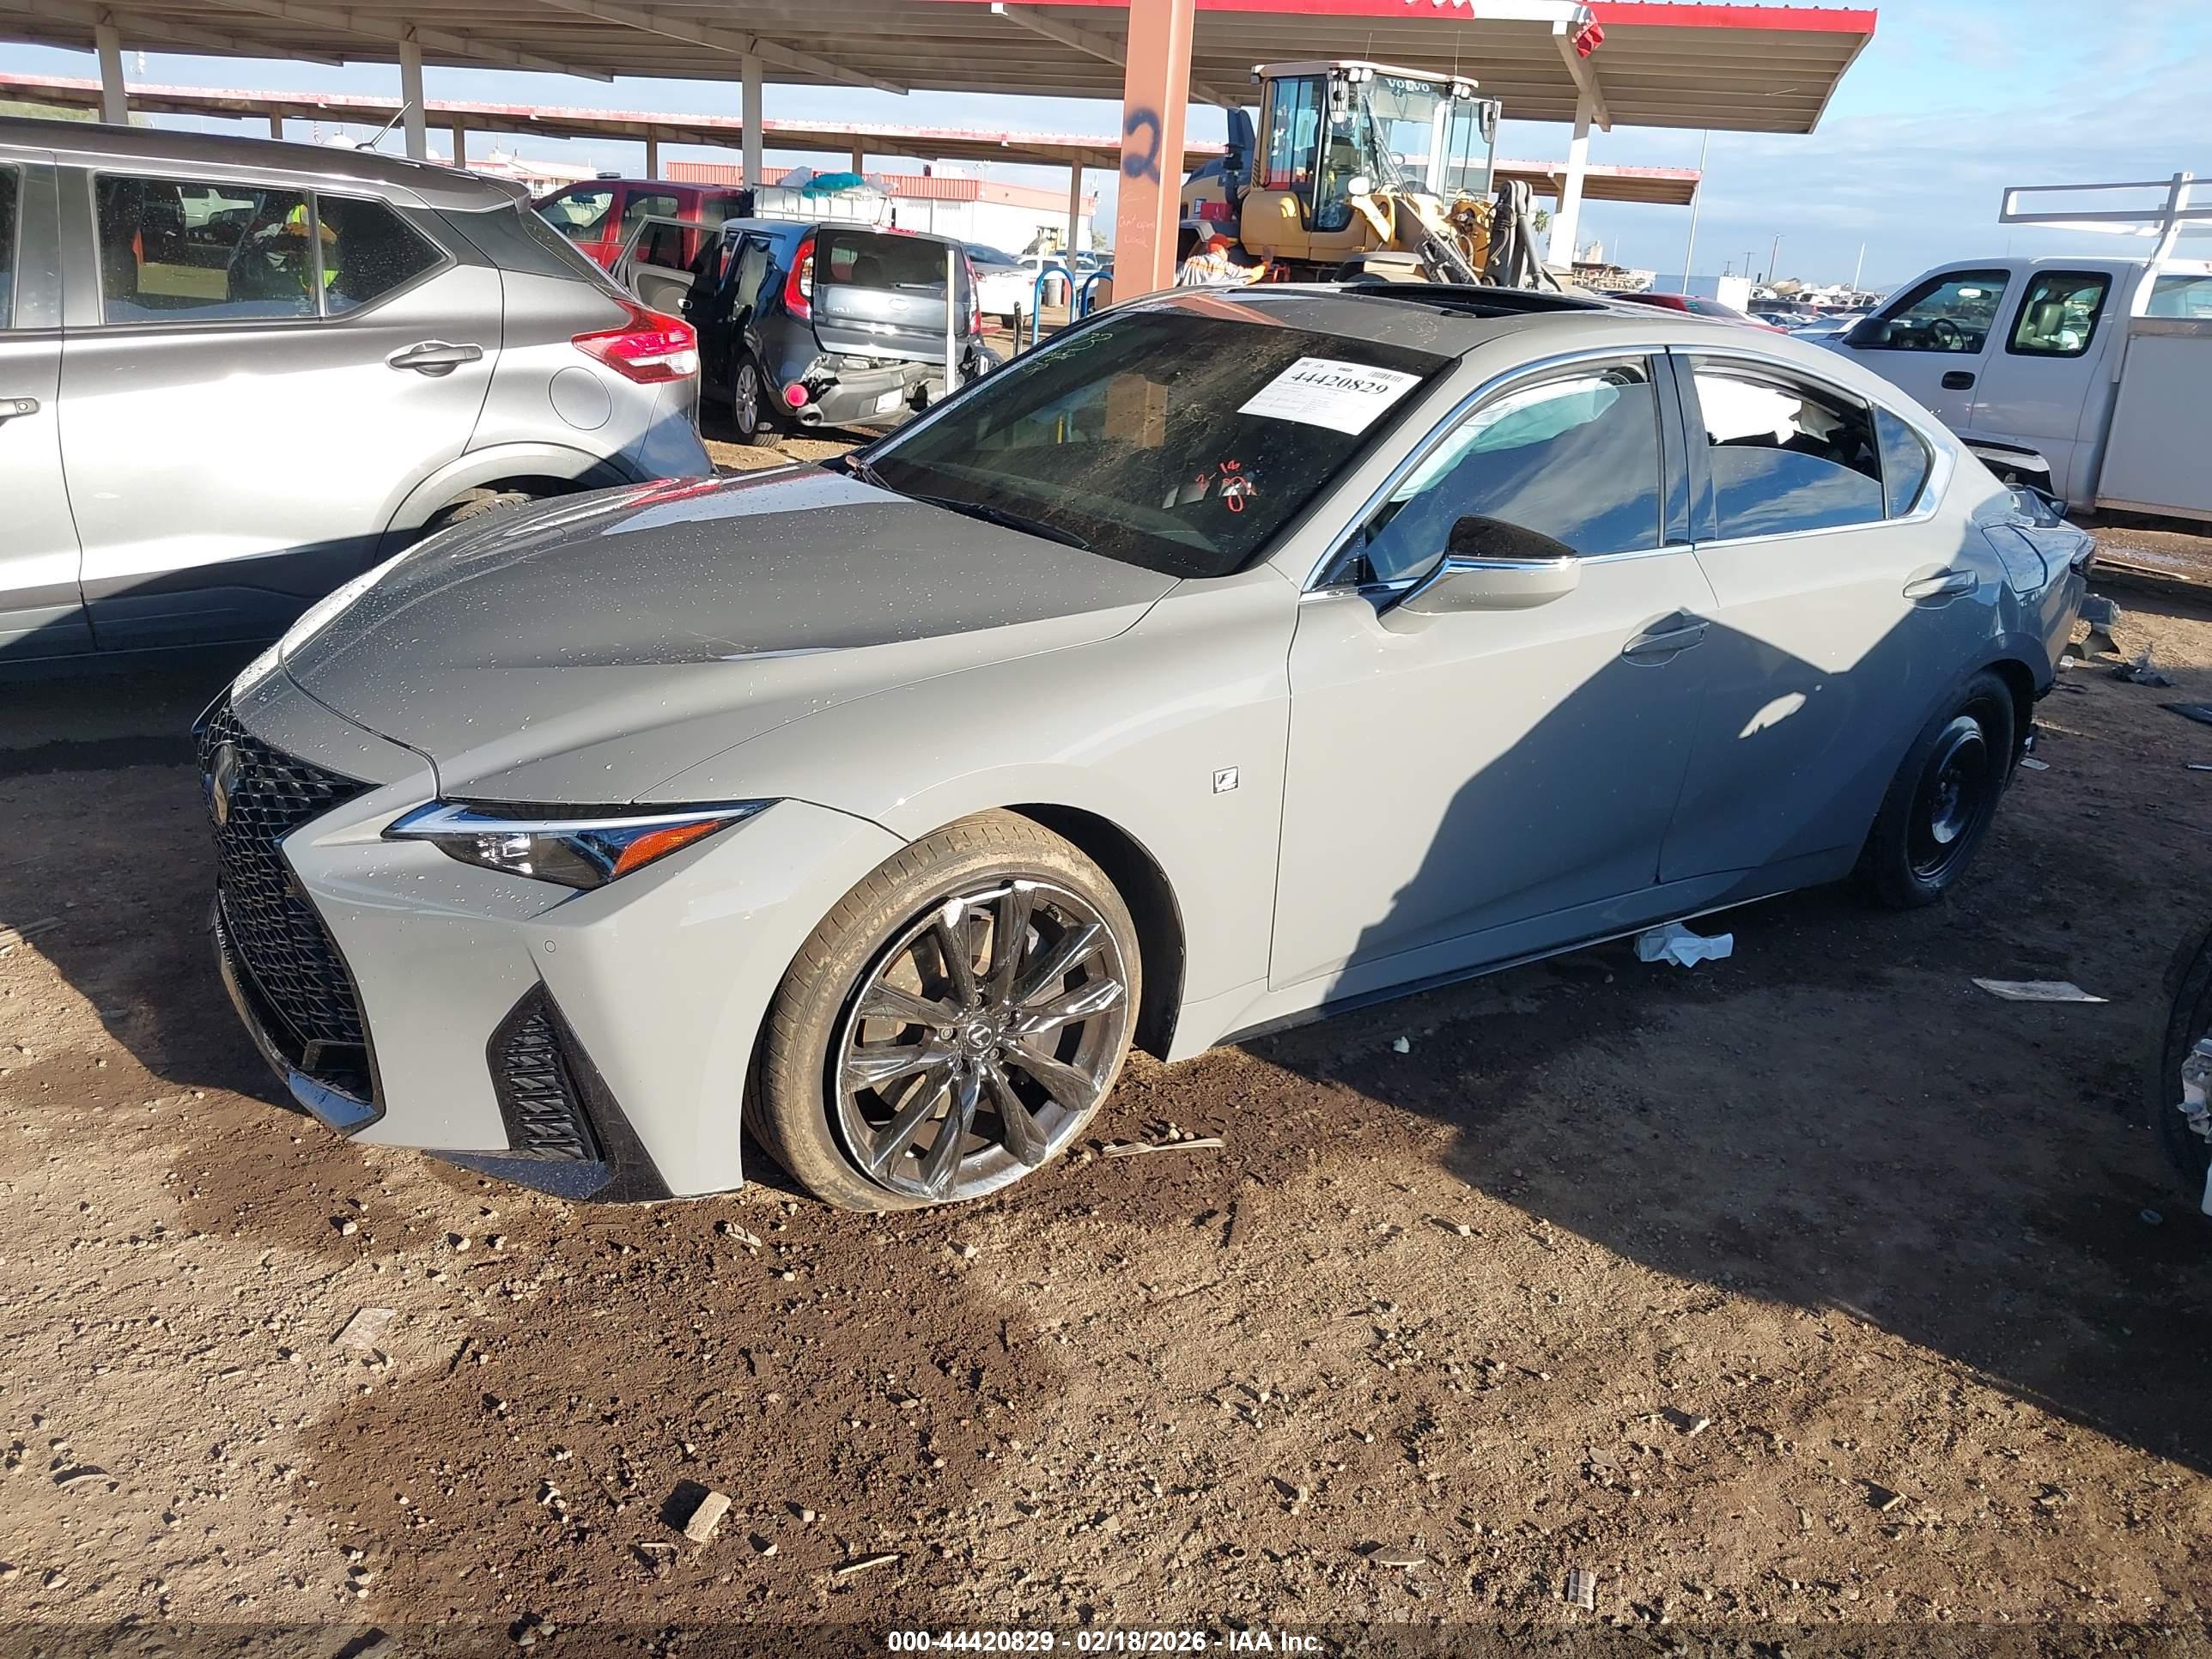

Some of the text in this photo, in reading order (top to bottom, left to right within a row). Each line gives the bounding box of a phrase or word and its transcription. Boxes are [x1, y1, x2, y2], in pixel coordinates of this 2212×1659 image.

[1384, 78, 1431, 93] VOLVO
[1123, 107, 1161, 185] 2
[1291, 371, 1389, 395] 44420829
